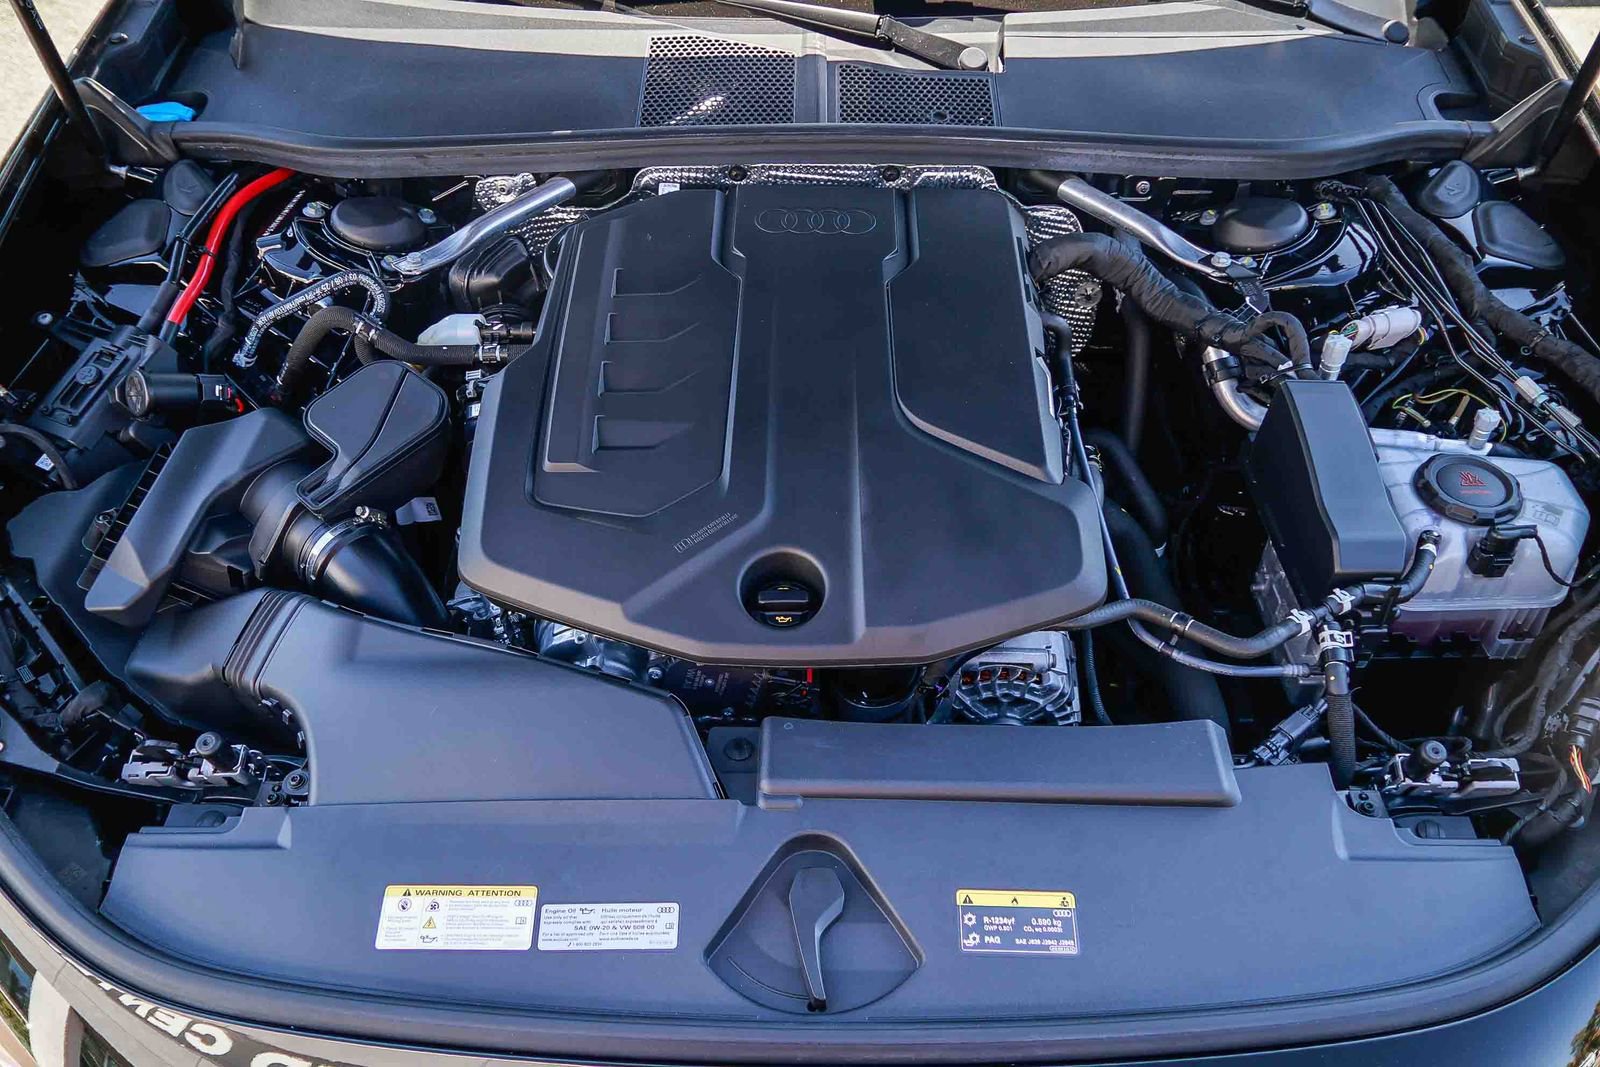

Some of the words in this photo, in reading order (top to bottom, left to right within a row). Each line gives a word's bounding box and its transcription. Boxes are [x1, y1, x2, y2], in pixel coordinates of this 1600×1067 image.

[415, 889, 462, 897] WARNING
[983, 916, 1015, 926] R-1234yf
[1053, 918, 1062, 928] kg
